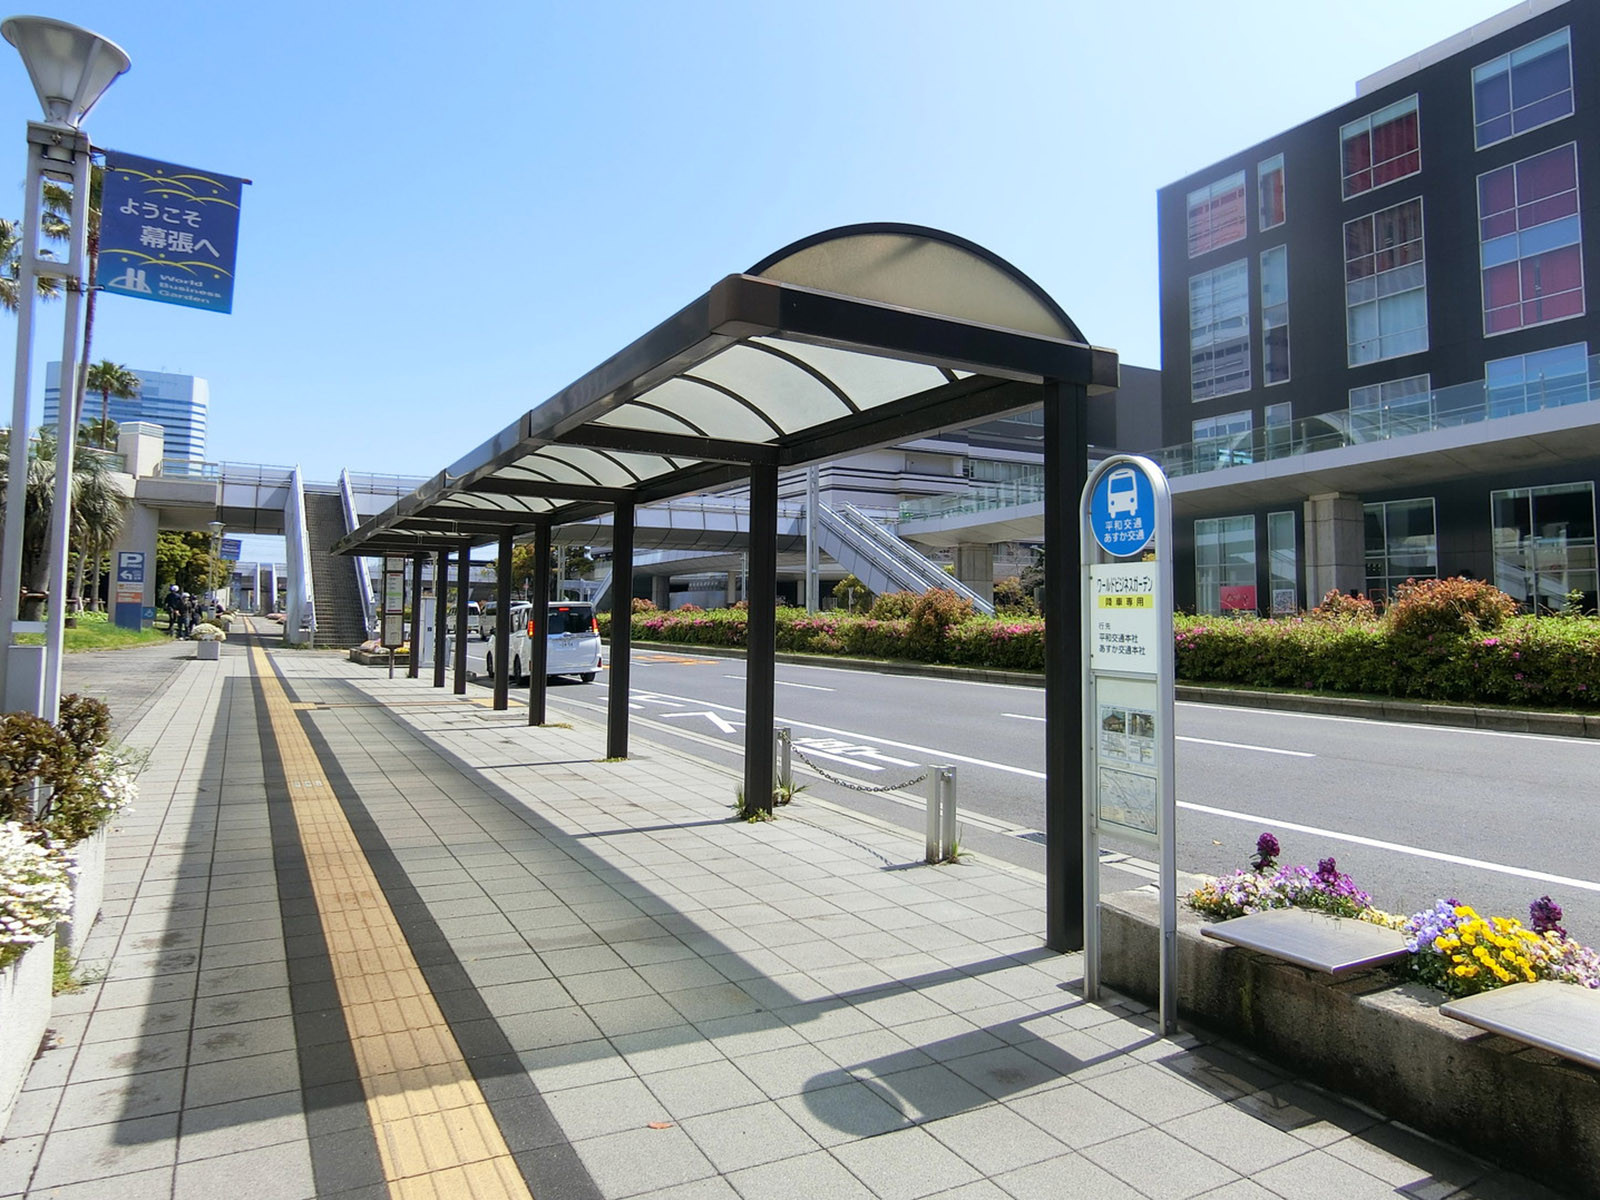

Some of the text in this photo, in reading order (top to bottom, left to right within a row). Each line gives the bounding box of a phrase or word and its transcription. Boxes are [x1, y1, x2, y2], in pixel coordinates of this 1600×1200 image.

[120, 198, 202, 228] ようこそ
[140, 225, 220, 258] 幕張へ
[160, 274, 204, 287] World
[158, 290, 210, 304] Garden
[159, 282, 222, 298] Business
[1105, 517, 1142, 531] 平和交通
[1103, 529, 1145, 543] あすか交通
[120, 553, 144, 568] P
[1097, 576, 1153, 592] ワールドビジネスガーデン
[1105, 596, 1144, 607] 降車専用
[1098, 621, 1111, 630] 行先
[1098, 632, 1138, 643] 平和交通本社
[1098, 644, 1146, 656] あすか交通本社
